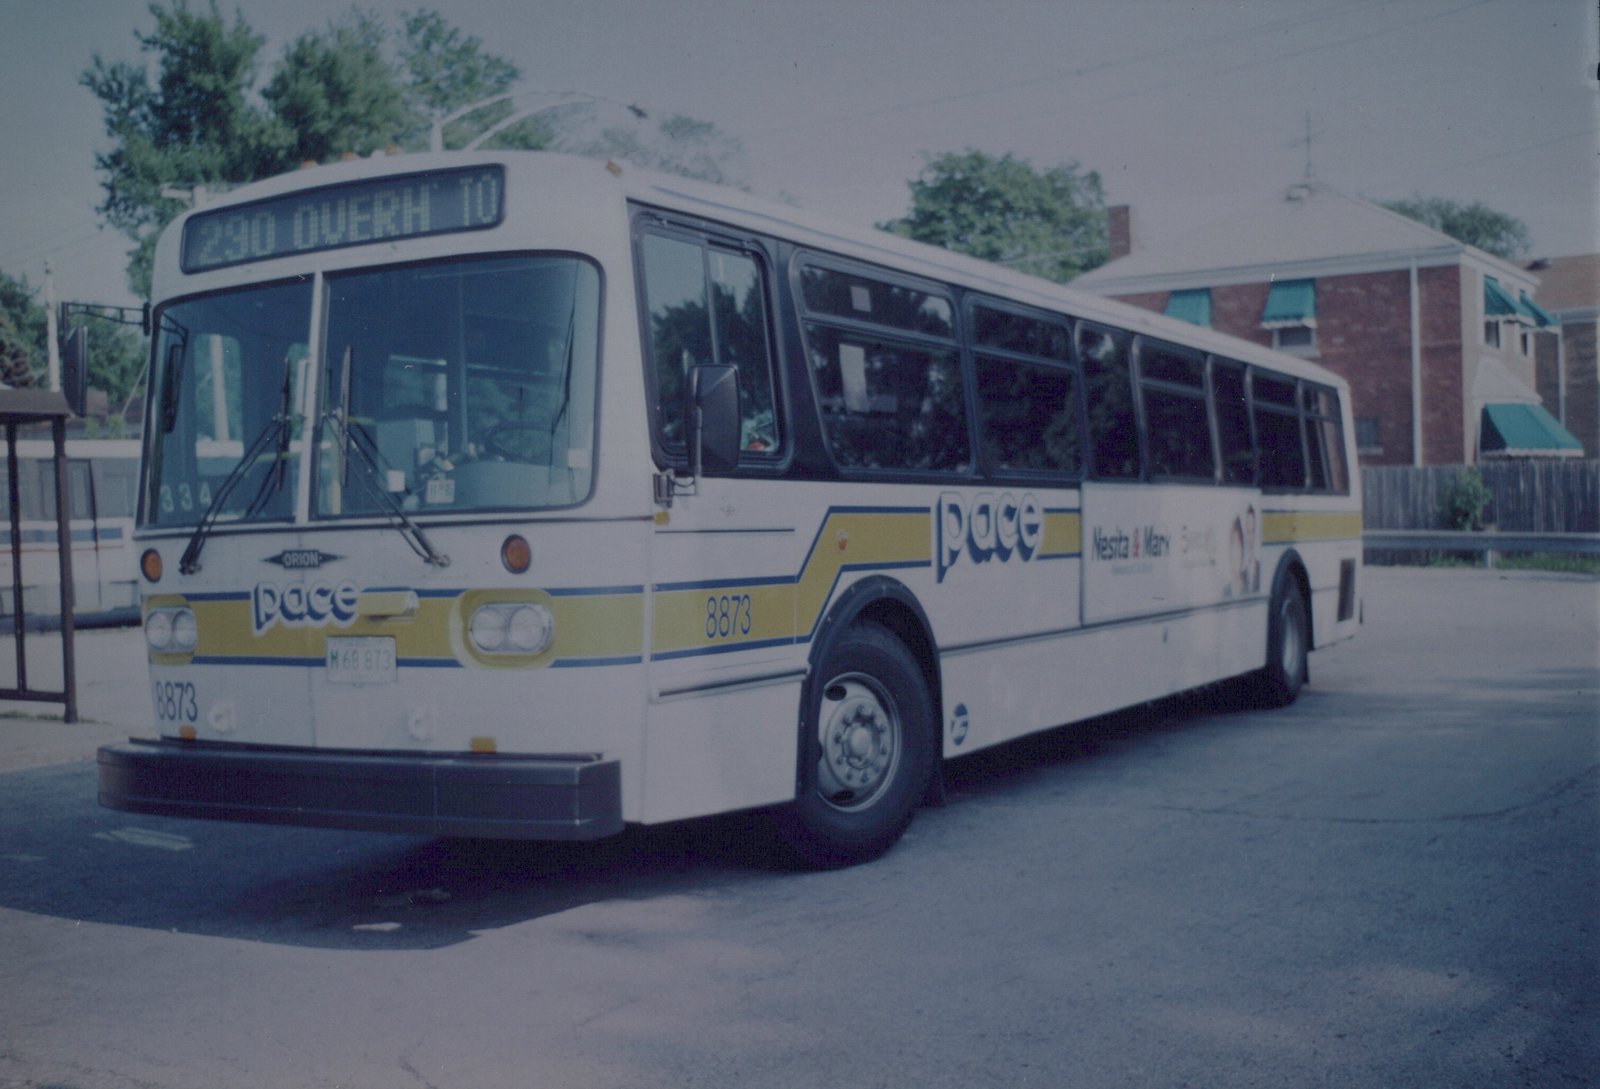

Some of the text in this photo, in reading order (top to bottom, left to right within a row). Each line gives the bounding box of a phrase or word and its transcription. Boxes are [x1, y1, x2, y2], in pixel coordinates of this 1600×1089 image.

[284, 552, 319, 567] ORION
[936, 491, 1043, 584] pace
[254, 582, 361, 636] pace
[705, 594, 752, 640] 8873
[155, 681, 198, 722] 8873
